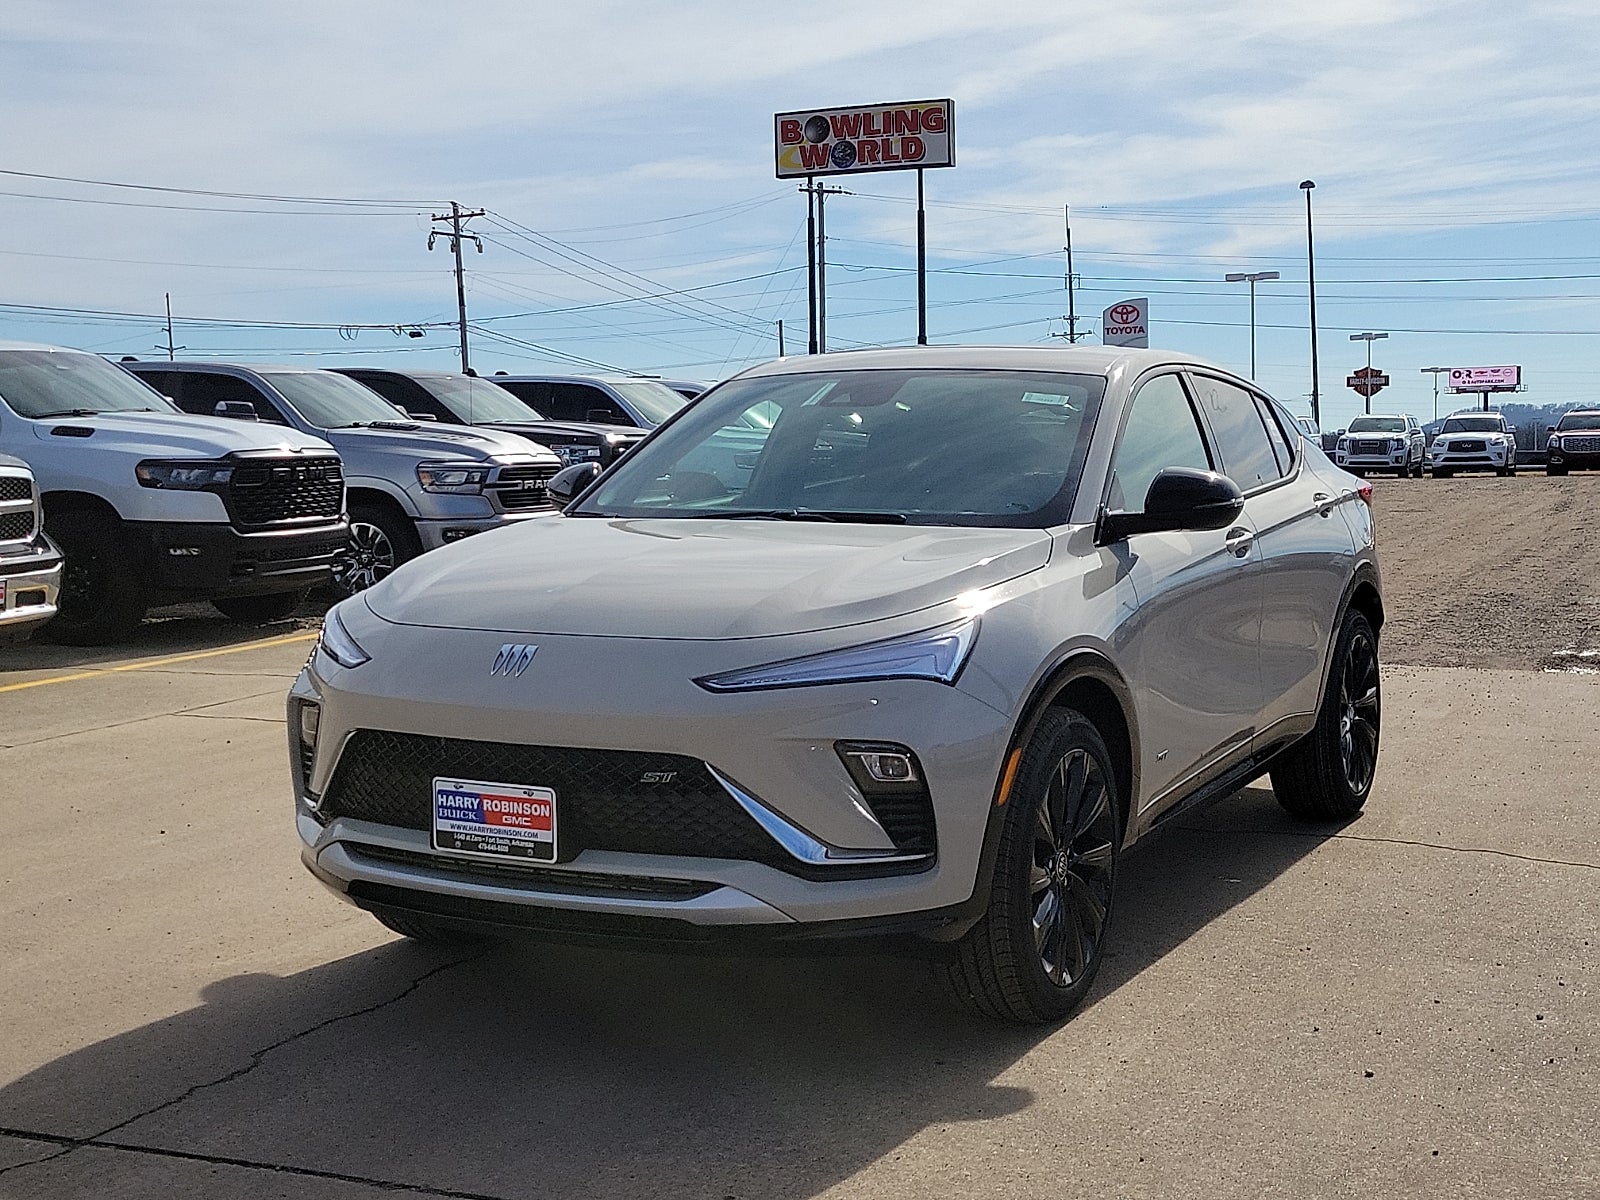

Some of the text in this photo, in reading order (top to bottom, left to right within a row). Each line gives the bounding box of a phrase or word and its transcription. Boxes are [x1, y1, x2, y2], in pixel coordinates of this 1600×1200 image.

[780, 107, 945, 145] BOWLING
[799, 136, 925, 169] WORLD
[1104, 325, 1146, 336] TOYOTA
[640, 771, 678, 783] ST
[438, 794, 550, 817] HARRY ROBINSON
[438, 808, 532, 825] BUICK GMC
[450, 823, 539, 839] WWW.HARRYROBINSON.COM
